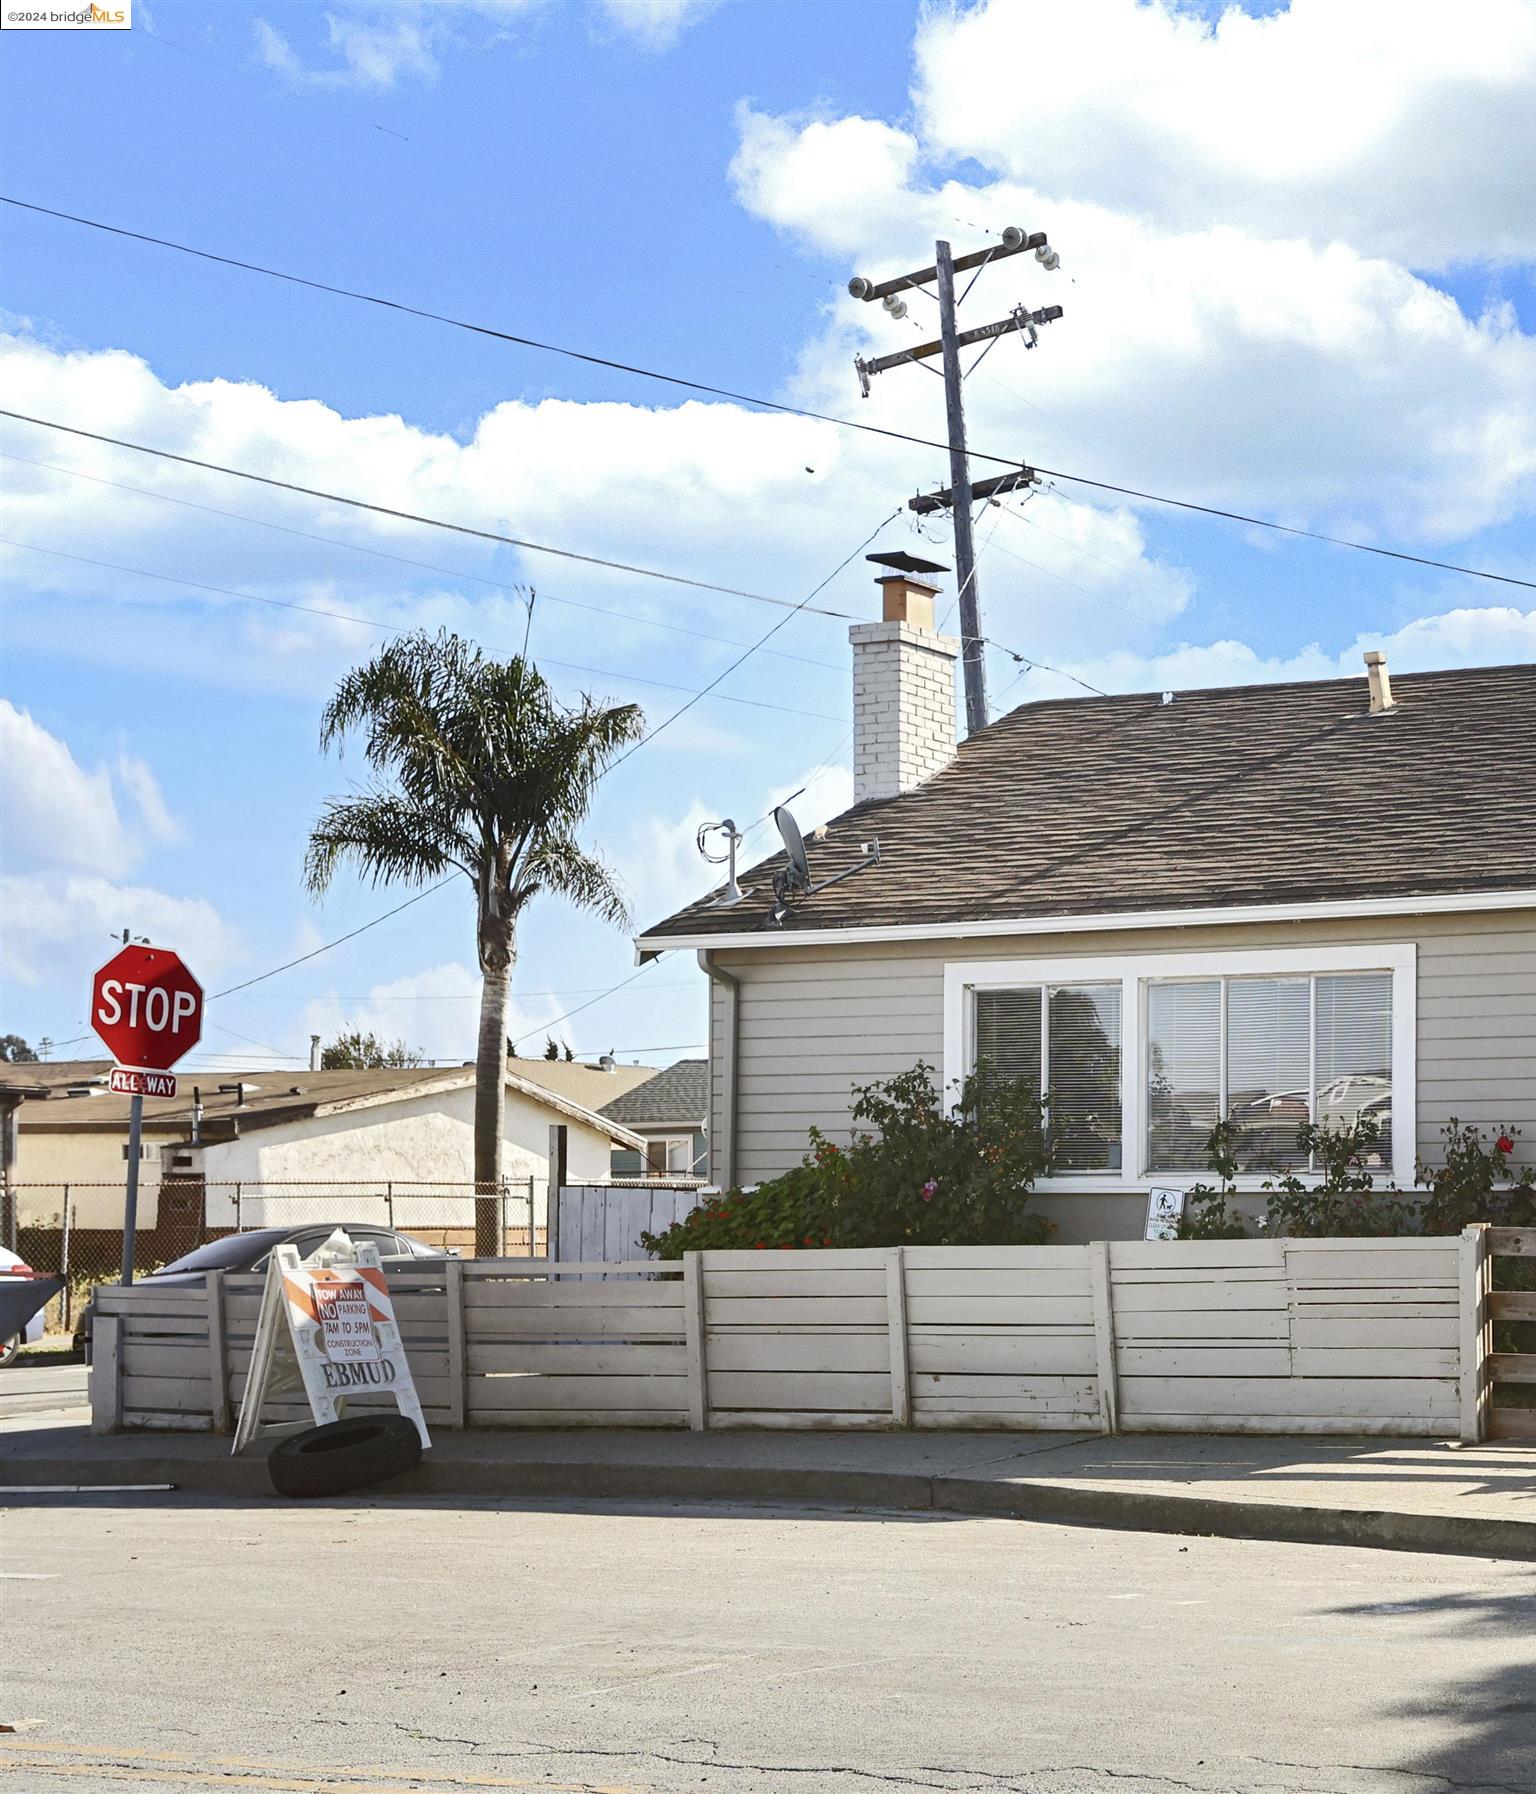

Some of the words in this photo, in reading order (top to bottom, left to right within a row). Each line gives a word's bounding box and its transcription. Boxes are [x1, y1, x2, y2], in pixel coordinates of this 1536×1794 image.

[98, 979, 197, 1034] STOP
[112, 1071, 138, 1091] ALL
[147, 1076, 175, 1095] WAY
[317, 1289, 337, 1300] TOW
[339, 1289, 364, 1300] AWAY
[321, 1303, 337, 1319] NO
[339, 1304, 367, 1315] PARKING
[325, 1322, 339, 1334] 7AM
[342, 1322, 352, 1334] TO
[355, 1322, 370, 1333] 5PM
[327, 1339, 373, 1349] CONSTRUCTION
[344, 1348, 362, 1357] ZONE
[320, 1359, 396, 1389] EBMUD
